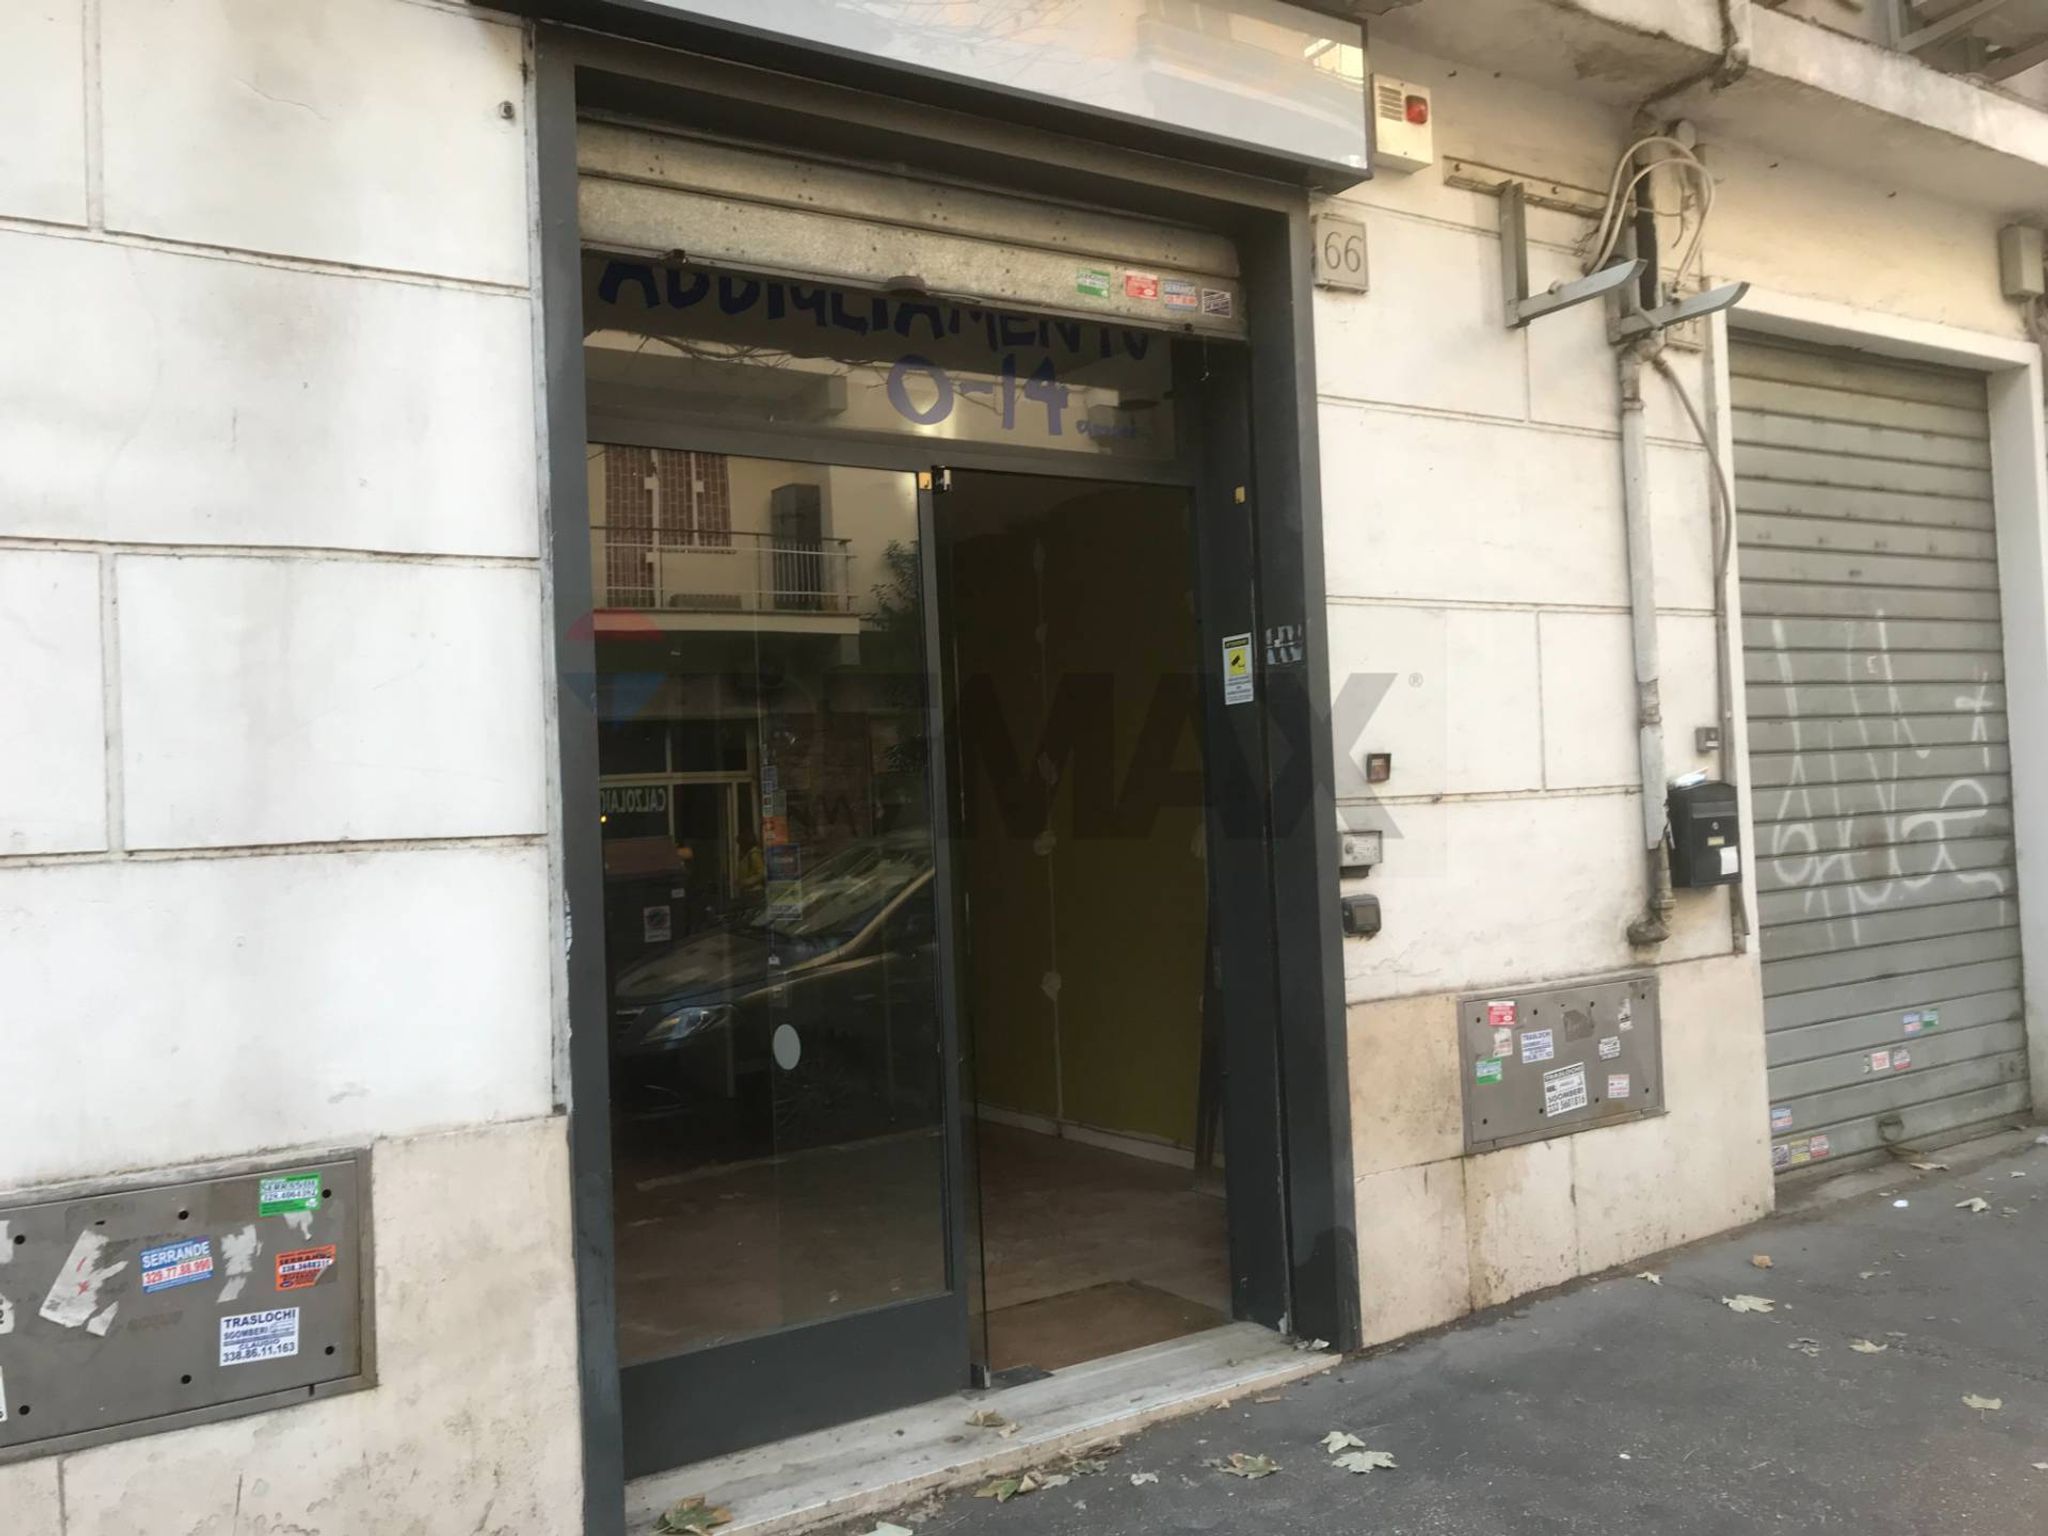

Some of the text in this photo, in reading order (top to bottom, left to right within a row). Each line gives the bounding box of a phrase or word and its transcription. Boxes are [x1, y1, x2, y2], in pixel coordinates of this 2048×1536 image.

[1324, 231, 1362, 273] 66
[142, 1240, 210, 1269] SERRANDE
[224, 1309, 296, 1328] TRASLOCHI
